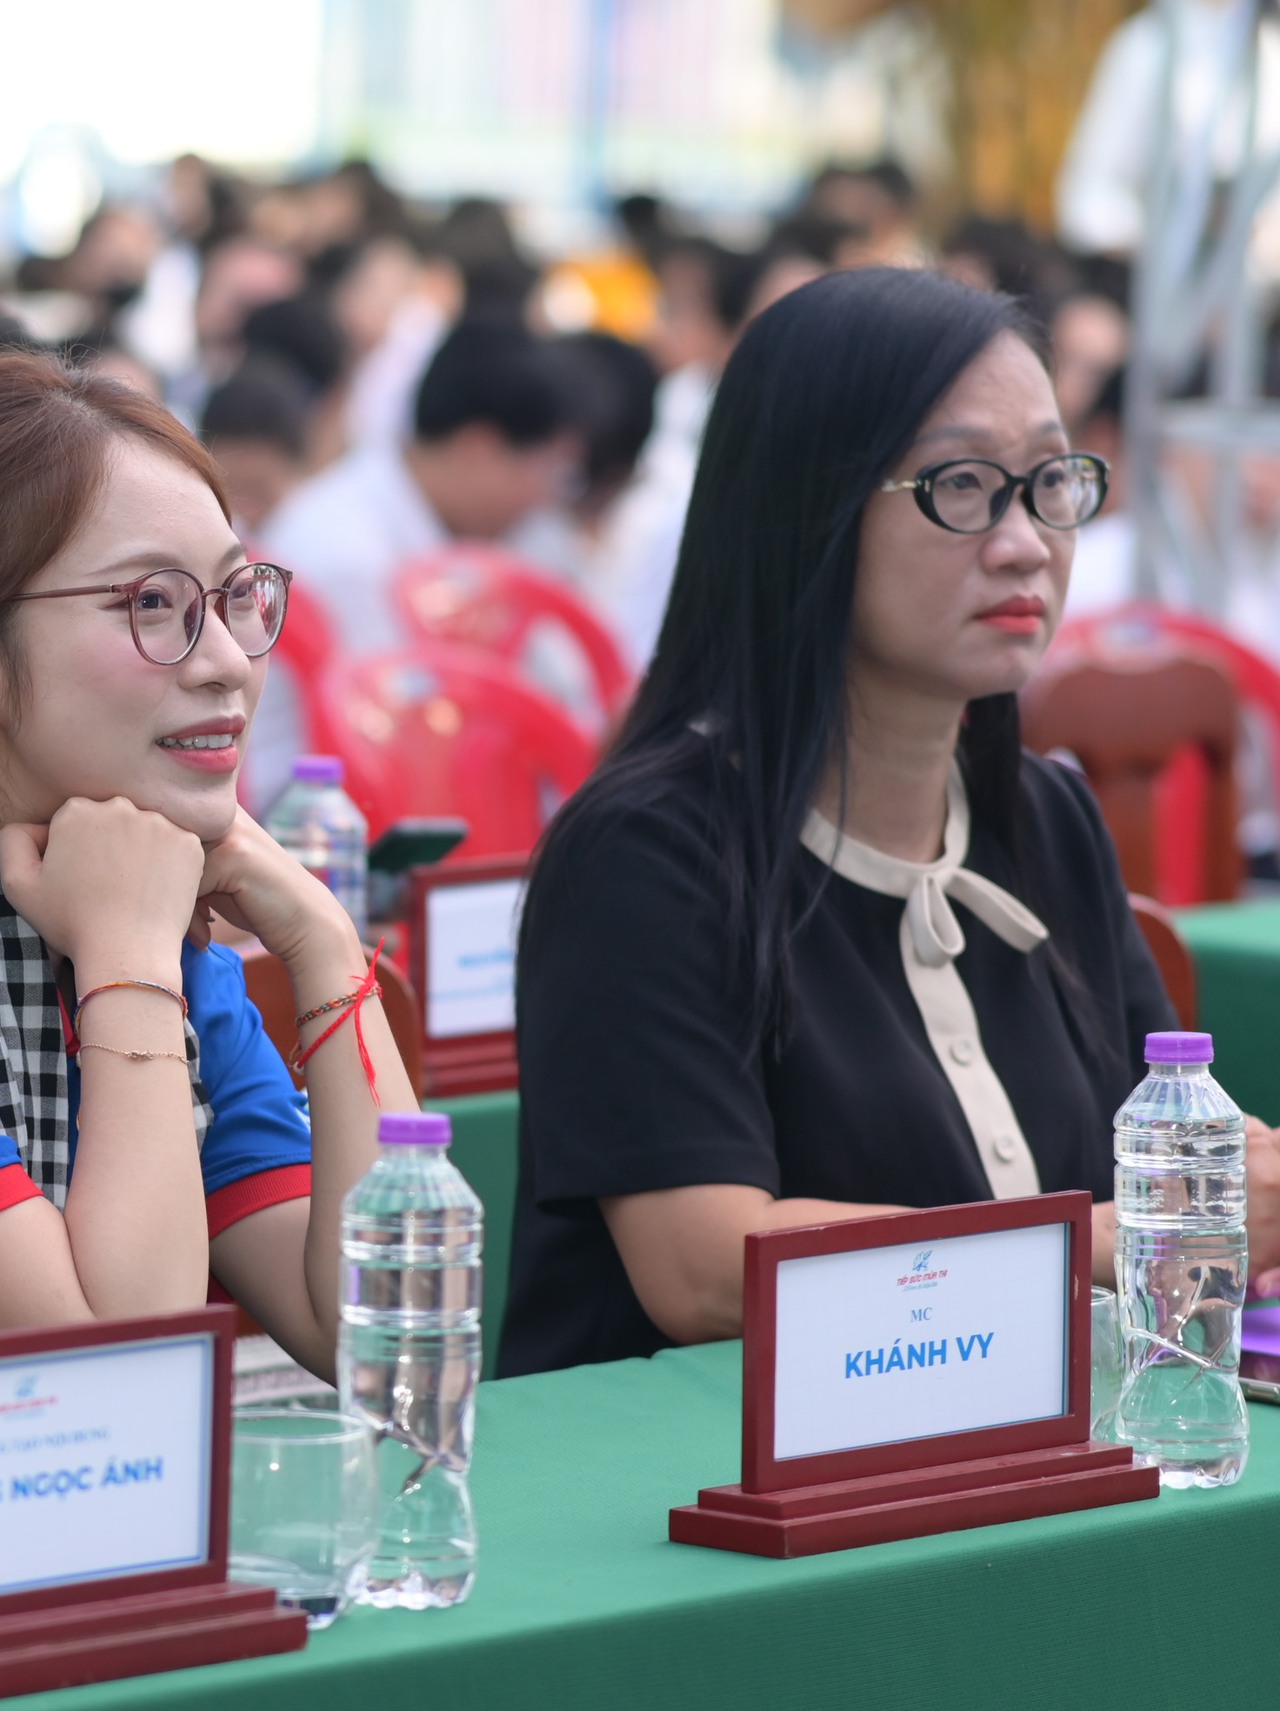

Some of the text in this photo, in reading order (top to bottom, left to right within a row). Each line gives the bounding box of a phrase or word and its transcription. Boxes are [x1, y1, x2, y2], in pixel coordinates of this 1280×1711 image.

[910, 1306, 933, 1323] MC
[844, 1332, 995, 1379] KHÁNH VY
[10, 1465, 94, 1500] NGỌC
